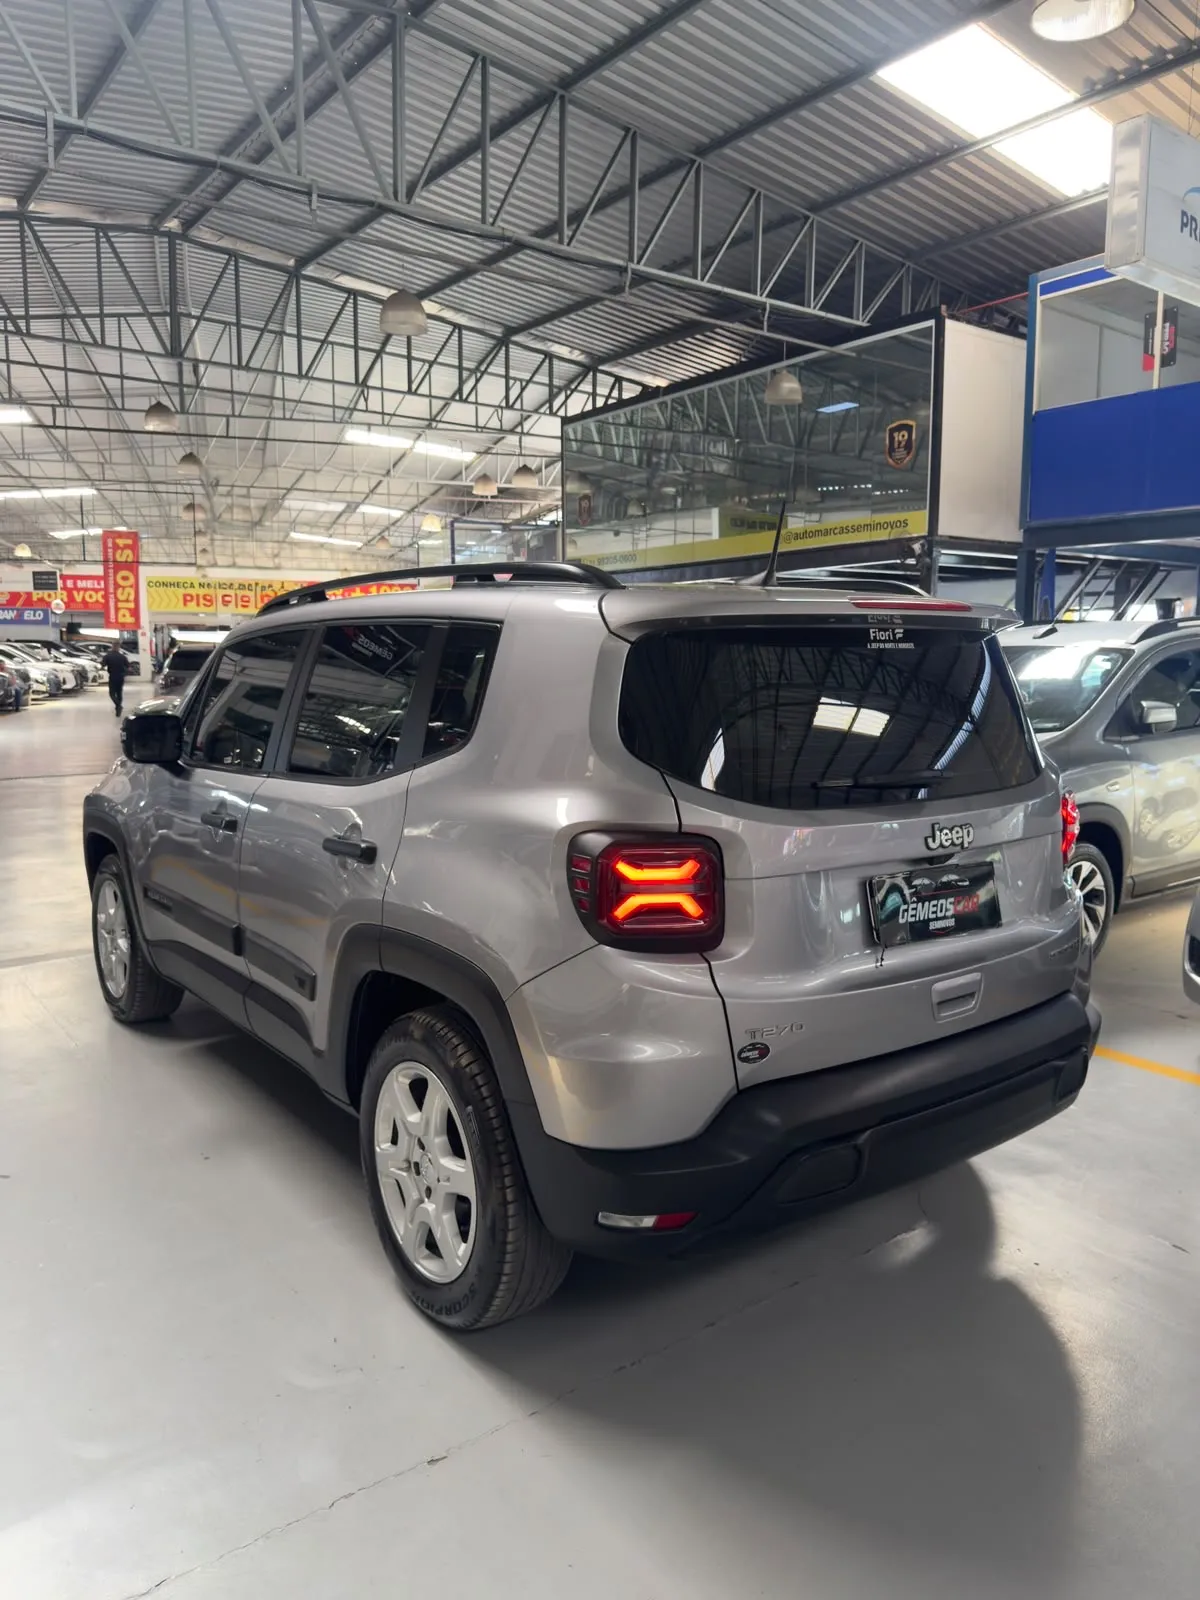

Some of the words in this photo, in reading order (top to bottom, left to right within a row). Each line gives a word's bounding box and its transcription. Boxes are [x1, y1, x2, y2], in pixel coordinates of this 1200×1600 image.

[1180, 209, 1200, 243] PR
[783, 518, 909, 544] @automarcasseminovos
[115, 538, 134, 562] S1
[116, 570, 136, 624] PISO
[147, 580, 196, 590] CONHEÇA
[32, 591, 68, 604] POR
[869, 628, 893, 640] Fiori
[925, 822, 974, 851] Jeep
[745, 1021, 805, 1040] T270
